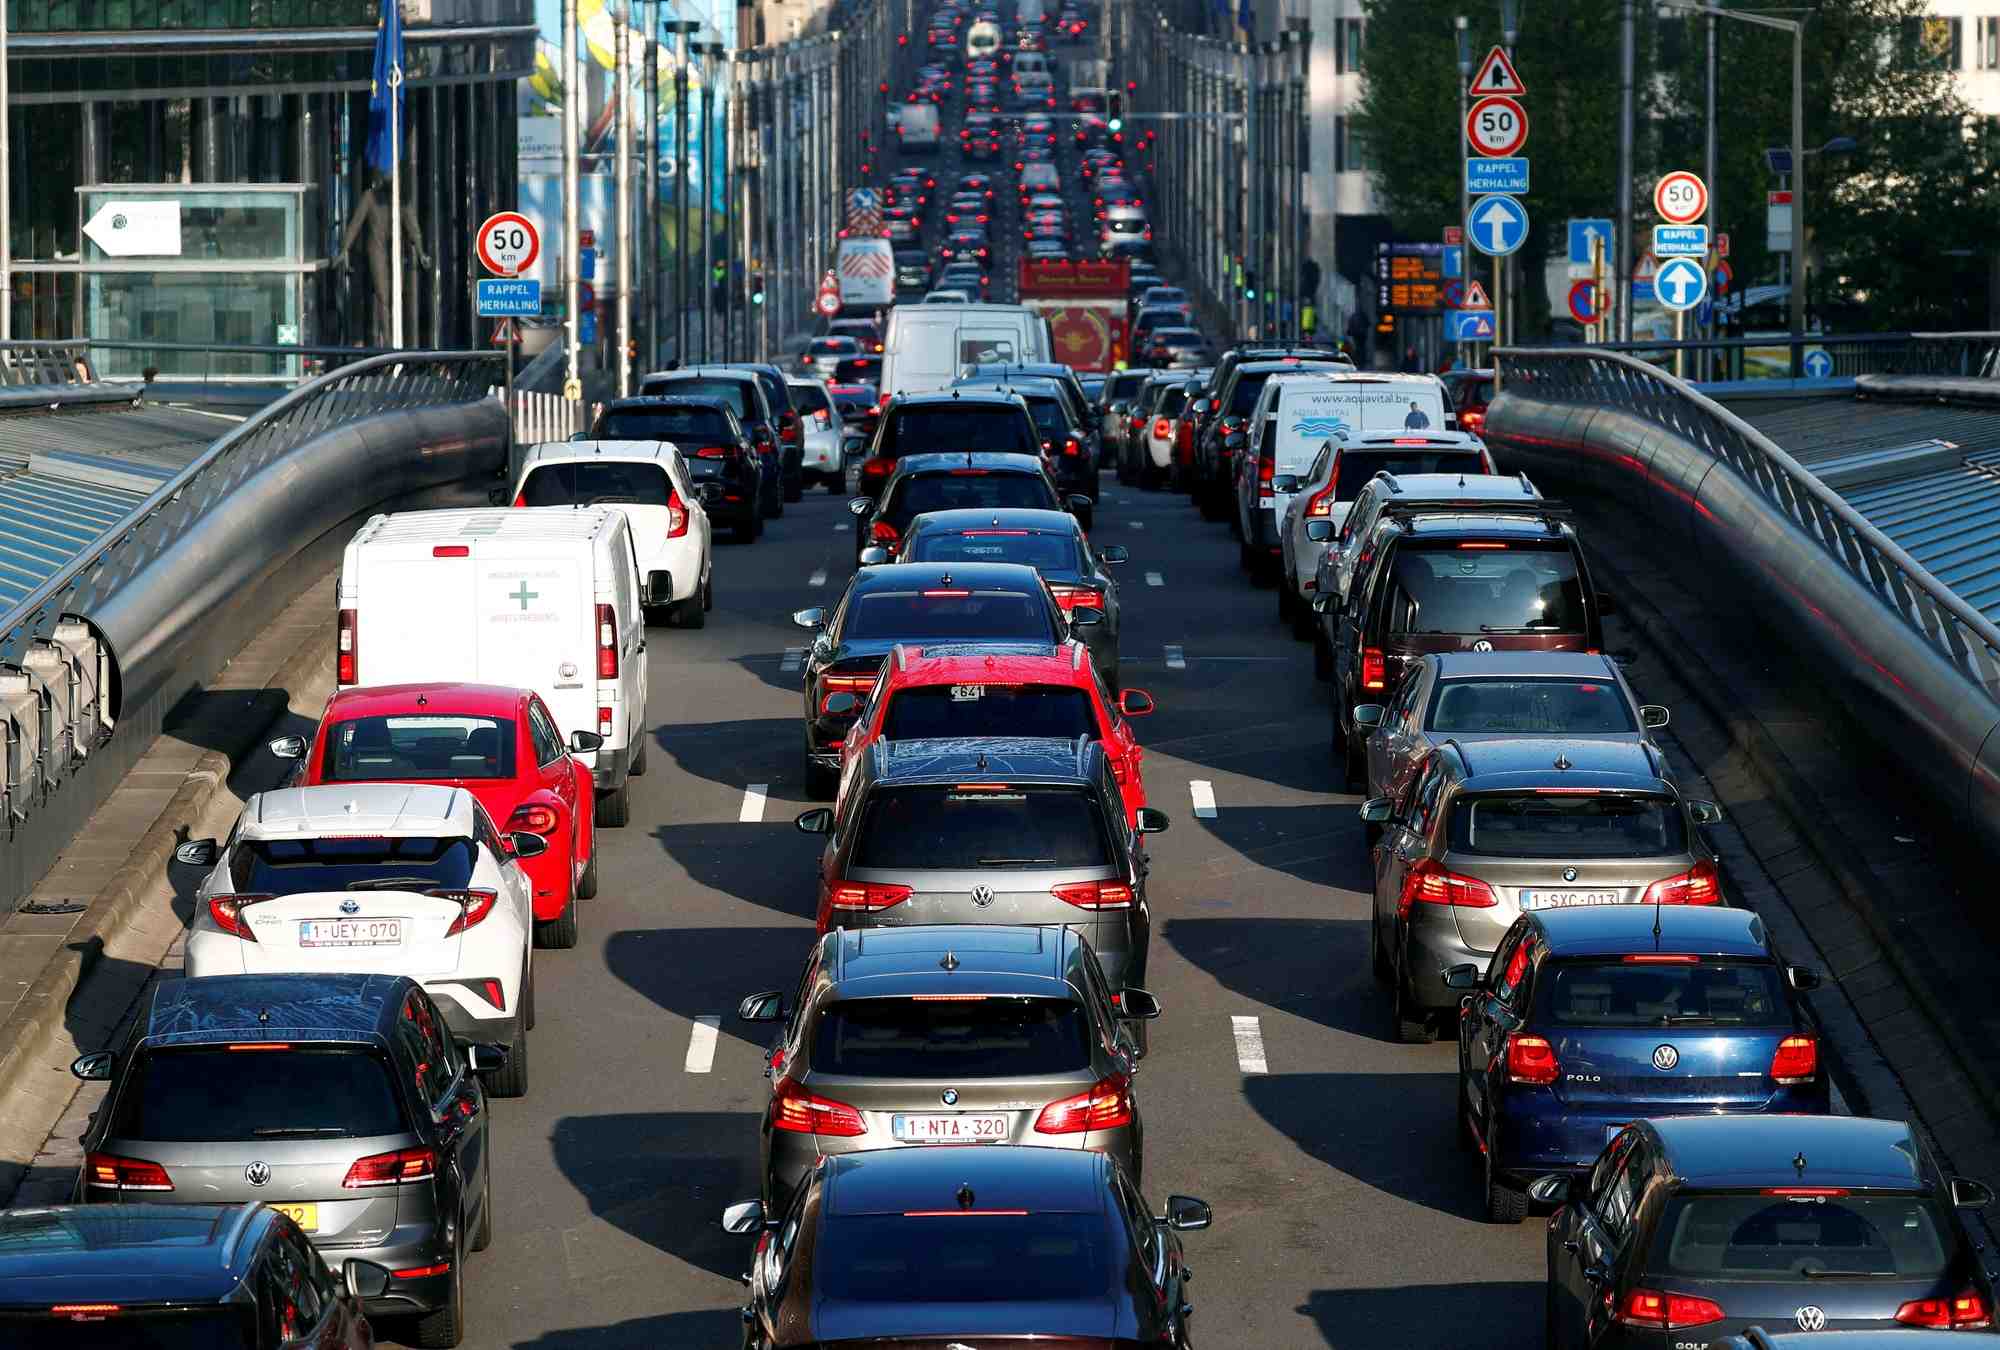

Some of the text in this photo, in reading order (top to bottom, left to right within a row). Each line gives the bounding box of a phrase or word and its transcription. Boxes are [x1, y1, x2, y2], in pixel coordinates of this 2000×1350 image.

[1482, 111, 1513, 132] 50
[1477, 164, 1517, 173] RAPPEL
[1469, 178, 1527, 189] HERHALING
[1669, 186, 1694, 201] 50
[493, 229, 524, 250] 50
[500, 251, 516, 261] km
[487, 284, 529, 295] RAPPEL
[479, 300, 539, 311] HERHALING
[1311, 391, 1410, 408] www.aquavital.be
[1566, 1074, 1601, 1083] POLO
[910, 1119, 1004, 1135] 1-NTA-320
